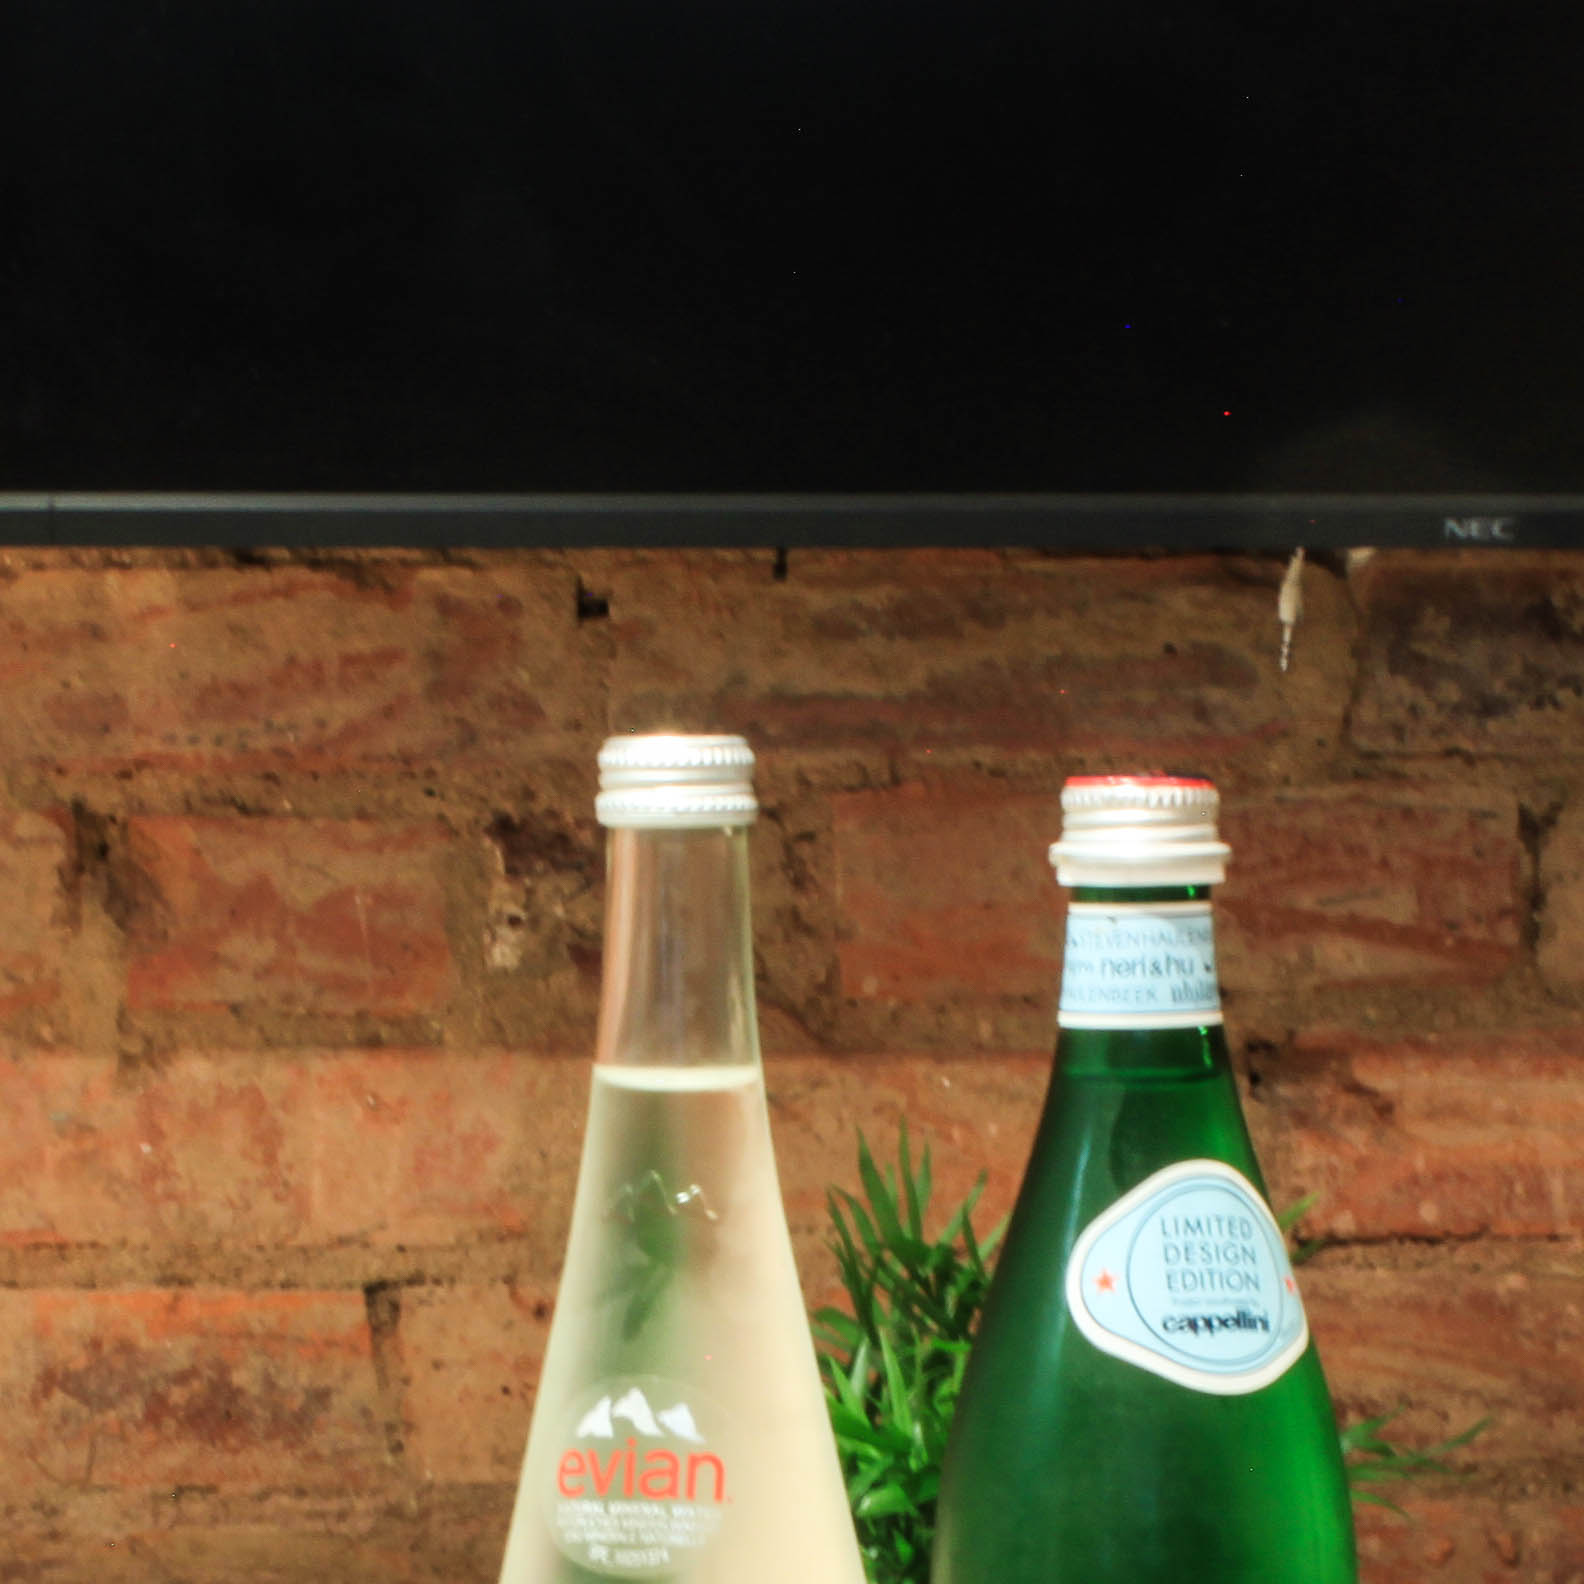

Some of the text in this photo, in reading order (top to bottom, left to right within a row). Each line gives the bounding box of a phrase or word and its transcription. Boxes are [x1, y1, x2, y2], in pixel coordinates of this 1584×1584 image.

[1444, 516, 1514, 540] NEC
[1160, 1214, 1253, 1241] LIMITED
[1163, 1241, 1257, 1266] DESIGN
[1166, 1267, 1261, 1294] EDITION
[1161, 1309, 1271, 1338] cappellini
[556, 1437, 727, 1503] evian
